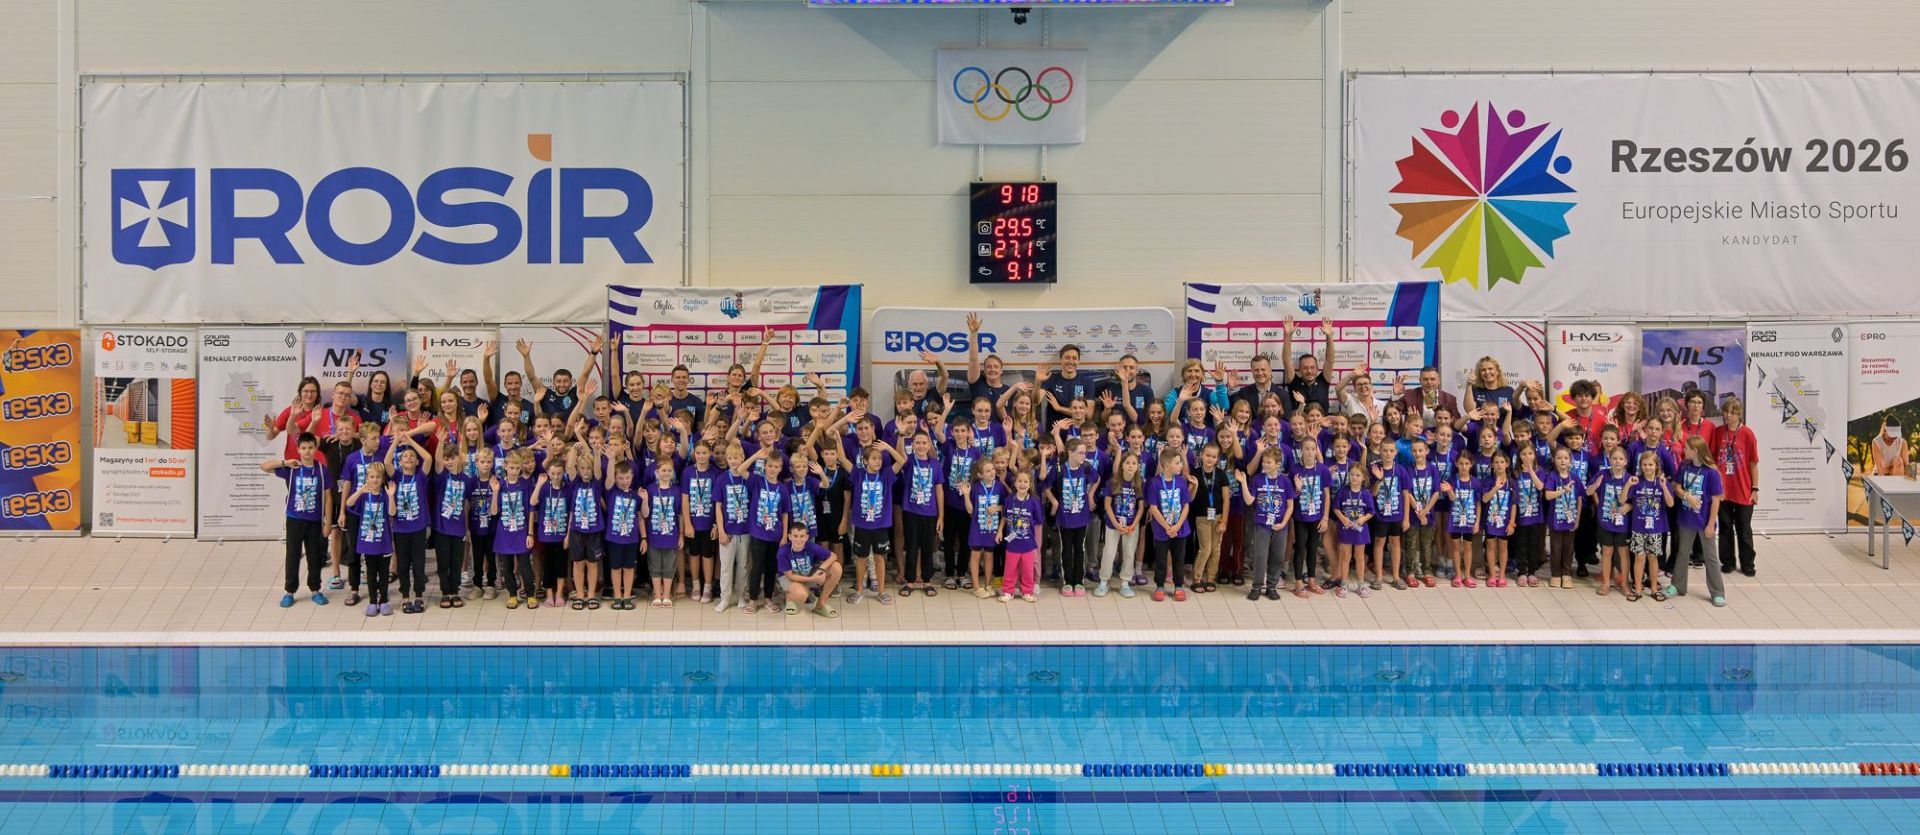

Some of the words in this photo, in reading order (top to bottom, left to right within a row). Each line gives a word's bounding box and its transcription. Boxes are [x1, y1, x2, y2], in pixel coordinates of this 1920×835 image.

[1611, 137, 1792, 173] Rzeszów
[1805, 138, 1909, 173] 2026
[1622, 201, 1743, 223] Europejskie
[1751, 201, 1821, 219] Miasto
[1828, 201, 1899, 223] Sportu
[994, 218, 1032, 236] 29.5
[994, 240, 1032, 258] 27.1
[1722, 235, 1799, 245] KANDYDAT
[1007, 262, 1032, 280] 9.1
[117, 335, 188, 347] STOKADO
[204, 339, 230, 347] PGD
[430, 338, 471, 347] HMS
[905, 331, 997, 353] ROSR
[1570, 332, 1611, 341] HMS
[11, 344, 71, 370] eska
[322, 348, 388, 367] NILS
[1660, 346, 1725, 366] NILS
[10, 393, 71, 419] eska
[10, 442, 71, 468] eska
[99, 456, 133, 465] Magazyny
[10, 490, 71, 516] eska
